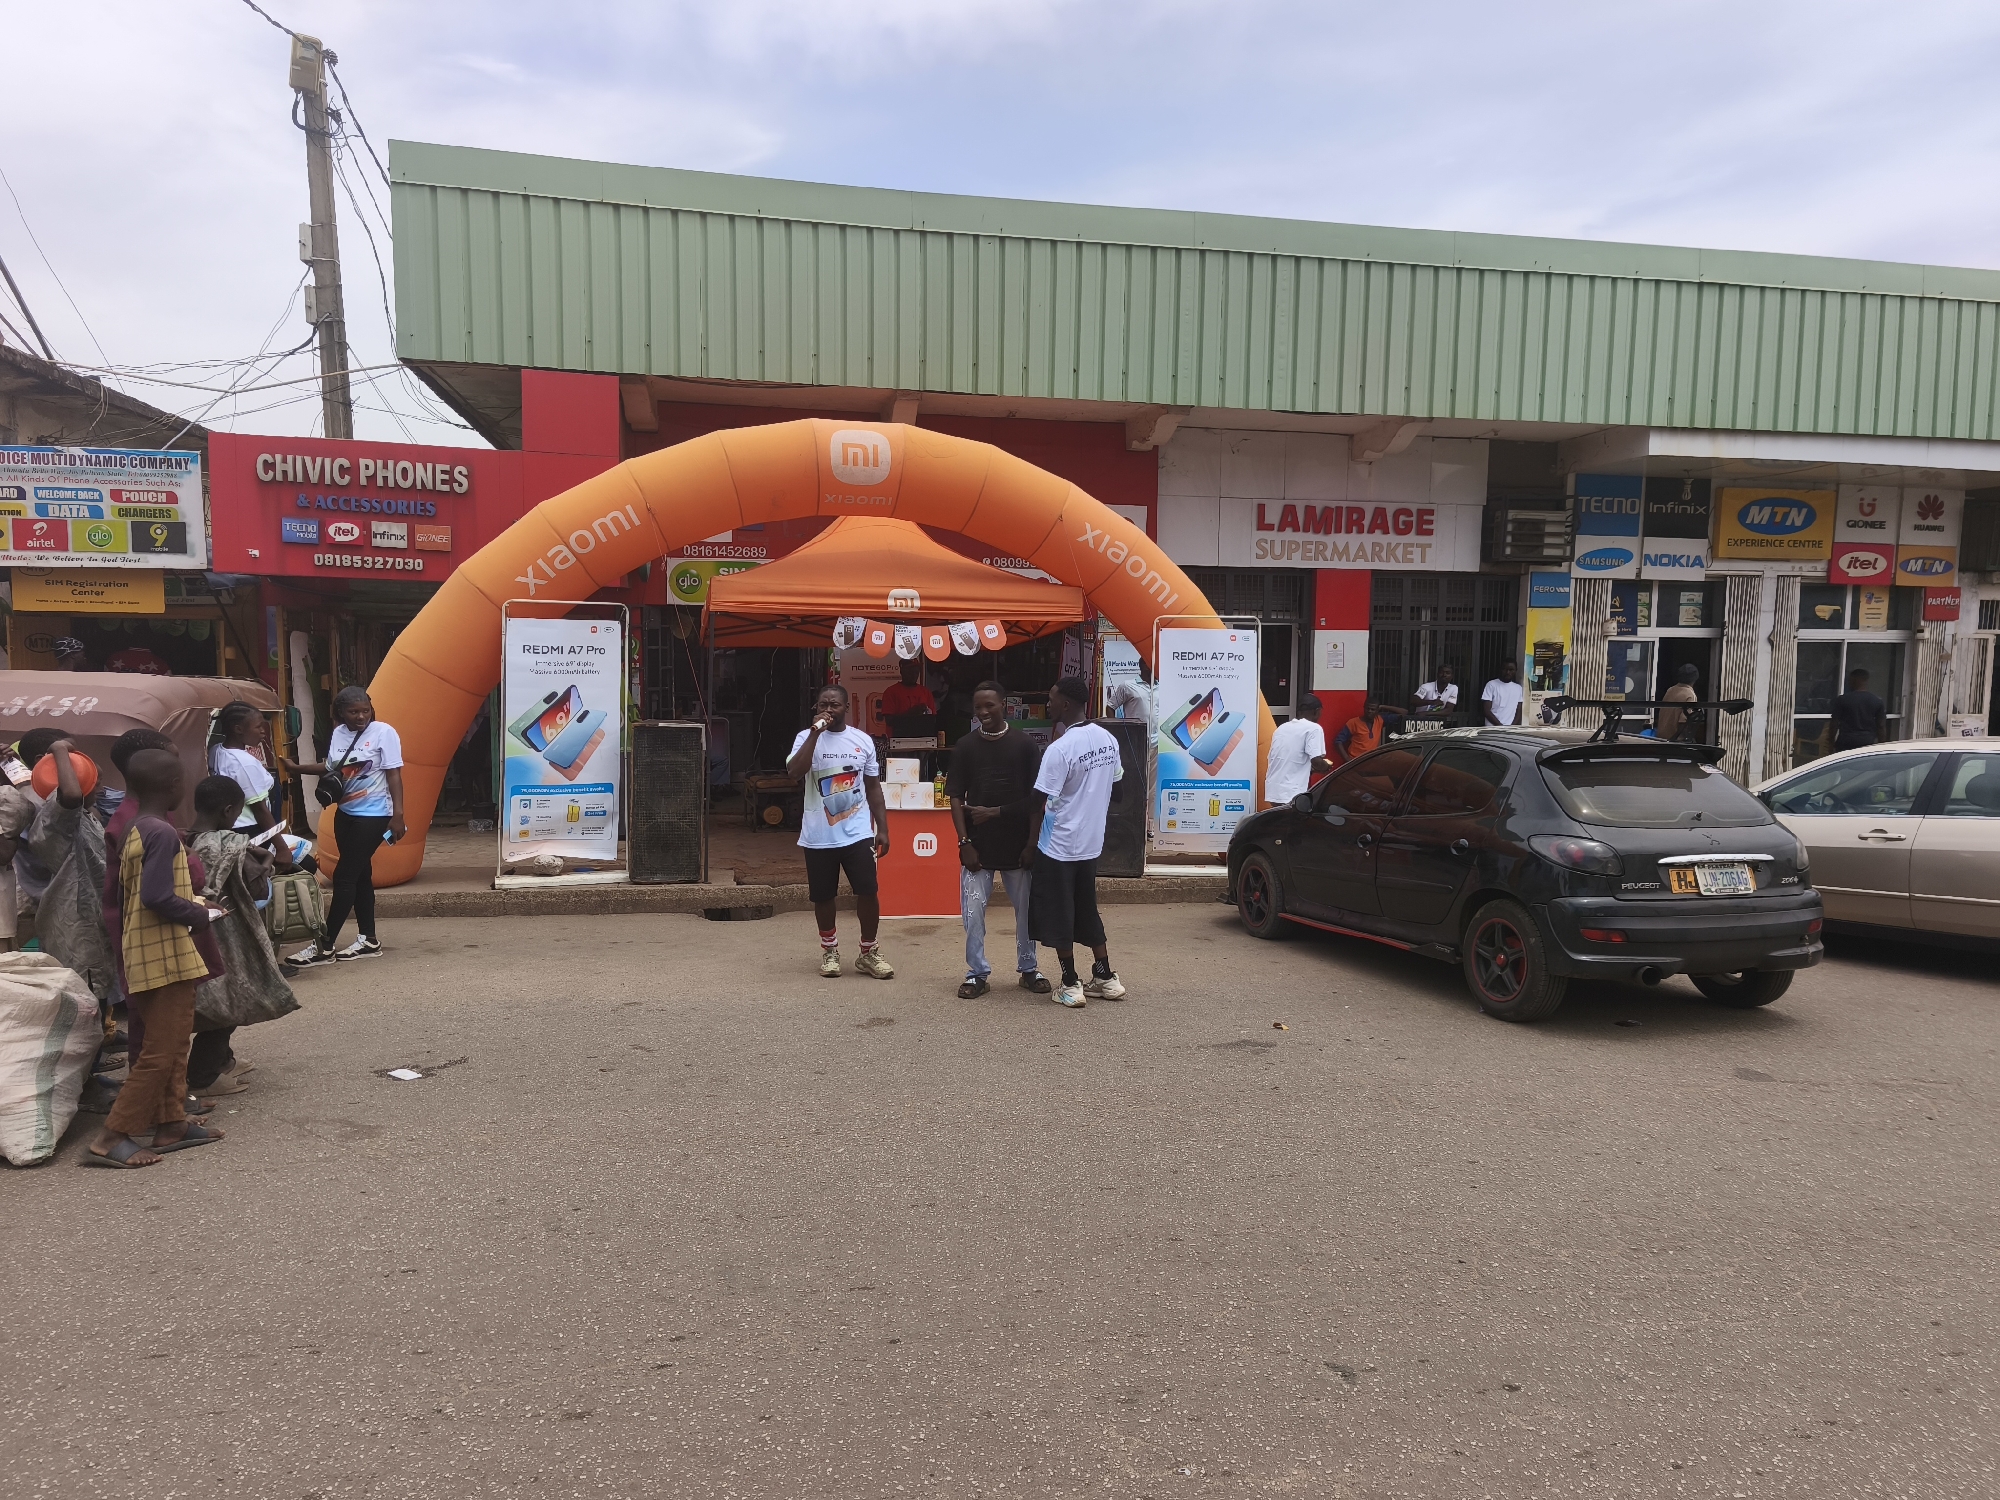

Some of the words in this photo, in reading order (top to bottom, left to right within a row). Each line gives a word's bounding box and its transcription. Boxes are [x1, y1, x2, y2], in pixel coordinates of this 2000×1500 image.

[30, 452, 126, 468] MULTIDYNAMIC
[130, 456, 190, 470] COMPANY
[256, 454, 350, 486] CHIVIC
[359, 458, 469, 494] PHONES
[37, 490, 76, 499] WELCOME
[78, 491, 100, 500] BACK
[122, 491, 166, 502] POUCH
[48, 504, 90, 517] DATA
[297, 494, 310, 507] &
[314, 494, 436, 516] ACCESSORIES
[1578, 497, 1640, 514] TECNO
[1649, 502, 1707, 515] Infinix
[118, 507, 171, 518] CHARGERS
[1746, 506, 1808, 526] MTN
[1256, 503, 1435, 536] LAMIRAGE
[1846, 520, 1886, 529] GIONEE
[284, 522, 317, 533] TECNO
[333, 526, 355, 537] itel
[1914, 524, 1945, 532] HUAWEI
[91, 530, 108, 542] glo
[150, 524, 168, 546] 9
[372, 529, 406, 542] Infinix
[27, 538, 55, 548] airtel
[1727, 538, 1784, 548] EXPERIENCE
[1787, 540, 1823, 549] CENTRE
[514, 504, 641, 596] xiaomi
[683, 545, 766, 557] 08161452689
[1255, 538, 1432, 564] SUPERMARKET
[314, 554, 424, 571] 08185327030
[1077, 522, 1178, 609] xiaomi
[1579, 556, 1625, 567] SAMSUNG
[1644, 554, 1705, 568] NOKIA
[1847, 556, 1878, 570] itel
[1907, 560, 1946, 573] MTN
[66, 580, 129, 588] Registration
[679, 574, 699, 589] glo
[1928, 595, 1959, 606] PARTNER
[522, 645, 564, 654] REDMI
[568, 646, 583, 655] A7
[586, 646, 606, 655] Pro
[1172, 652, 1207, 660] REDMI
[1228, 653, 1244, 661] Pro
[1405, 720, 1416, 732] NO
[1417, 720, 1443, 732] PARKING
